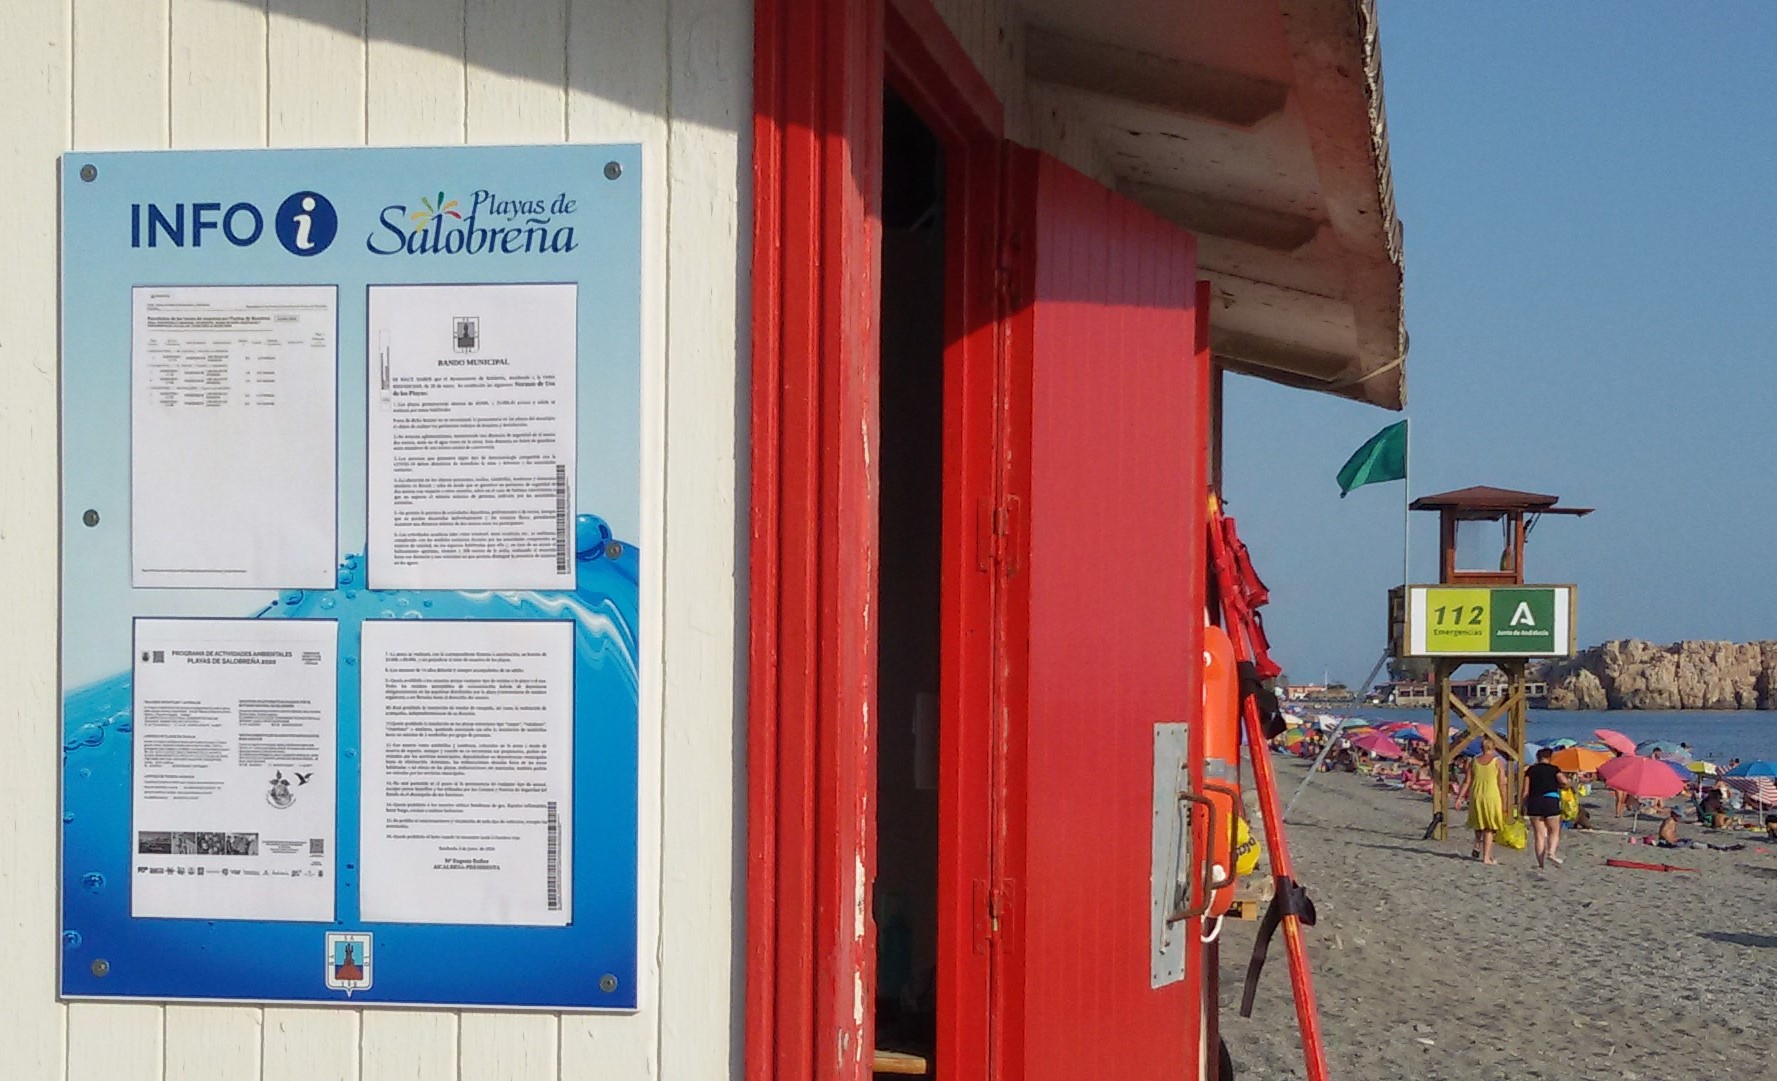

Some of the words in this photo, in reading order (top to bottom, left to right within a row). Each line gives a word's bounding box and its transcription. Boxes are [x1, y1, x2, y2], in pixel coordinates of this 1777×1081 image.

[469, 189, 547, 222] Playas
[551, 193, 577, 215] de
[131, 202, 264, 248] INFO
[366, 204, 579, 256] Salobreña
[437, 359, 465, 367] BANDO
[466, 358, 510, 366] MUNICIPAL
[1434, 606, 1484, 625] 112
[1433, 629, 1483, 638] Emergencias
[222, 657, 260, 665] SALOBREÑA
